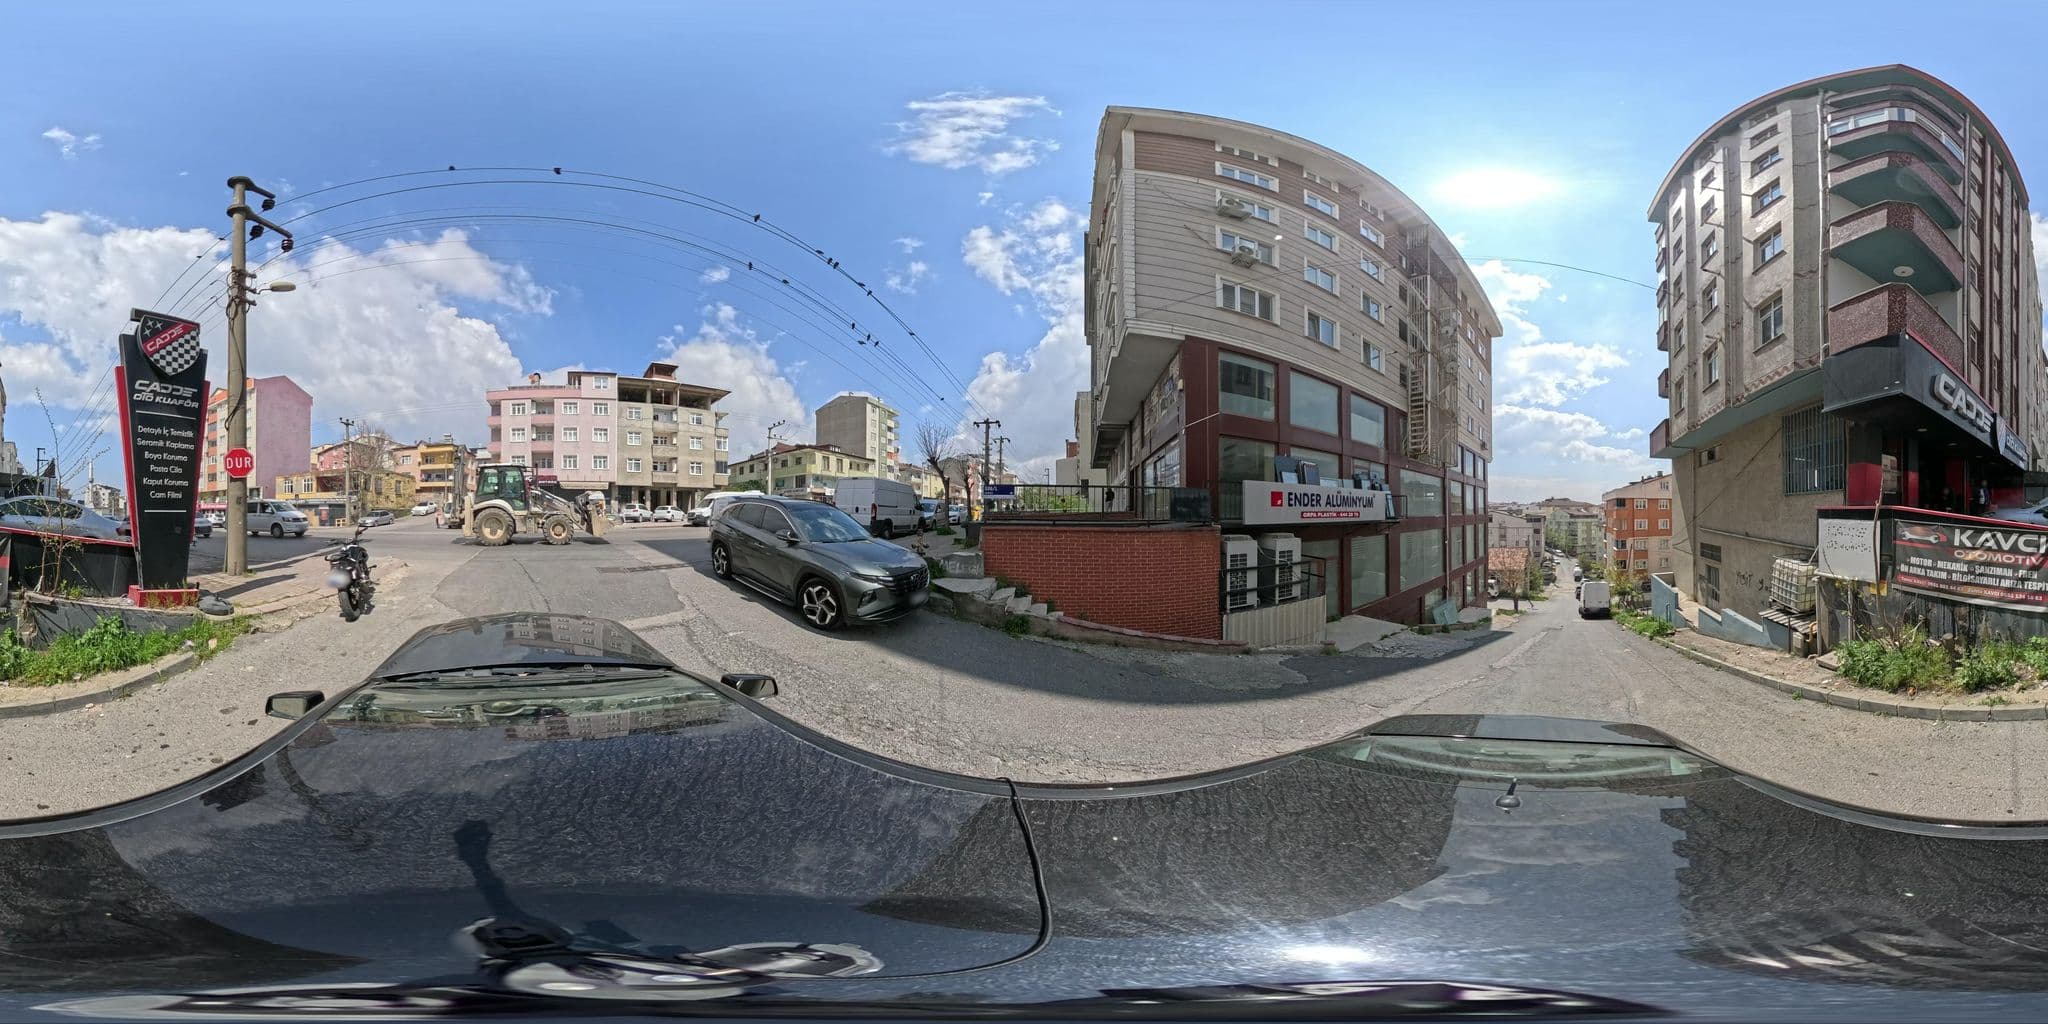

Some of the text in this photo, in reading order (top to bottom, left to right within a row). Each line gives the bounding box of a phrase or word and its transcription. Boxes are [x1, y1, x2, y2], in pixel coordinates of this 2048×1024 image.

[134, 379, 198, 397] CADDE
[155, 396, 200, 409] KUAFÖR
[165, 440, 195, 450] Kaplama
[144, 451, 188, 462] Boya Koruma
[226, 456, 252, 469] DUR
[164, 478, 189, 487] Koruma
[149, 490, 166, 499] Cam
[1287, 490, 1374, 508] ENDER ALÜMİNYUM
[1953, 528, 2047, 554] KAVCI
[1954, 549, 2043, 566] OTOMOTİV
[1910, 556, 1933, 567] MOTOR
[1937, 560, 1968, 572] MEKANİK
[2018, 569, 2038, 579] FREN
[1909, 566, 1926, 576] ARKA
[1926, 568, 1947, 580] TAKIM
[1952, 570, 1999, 586] BİLGİSAYARLI
